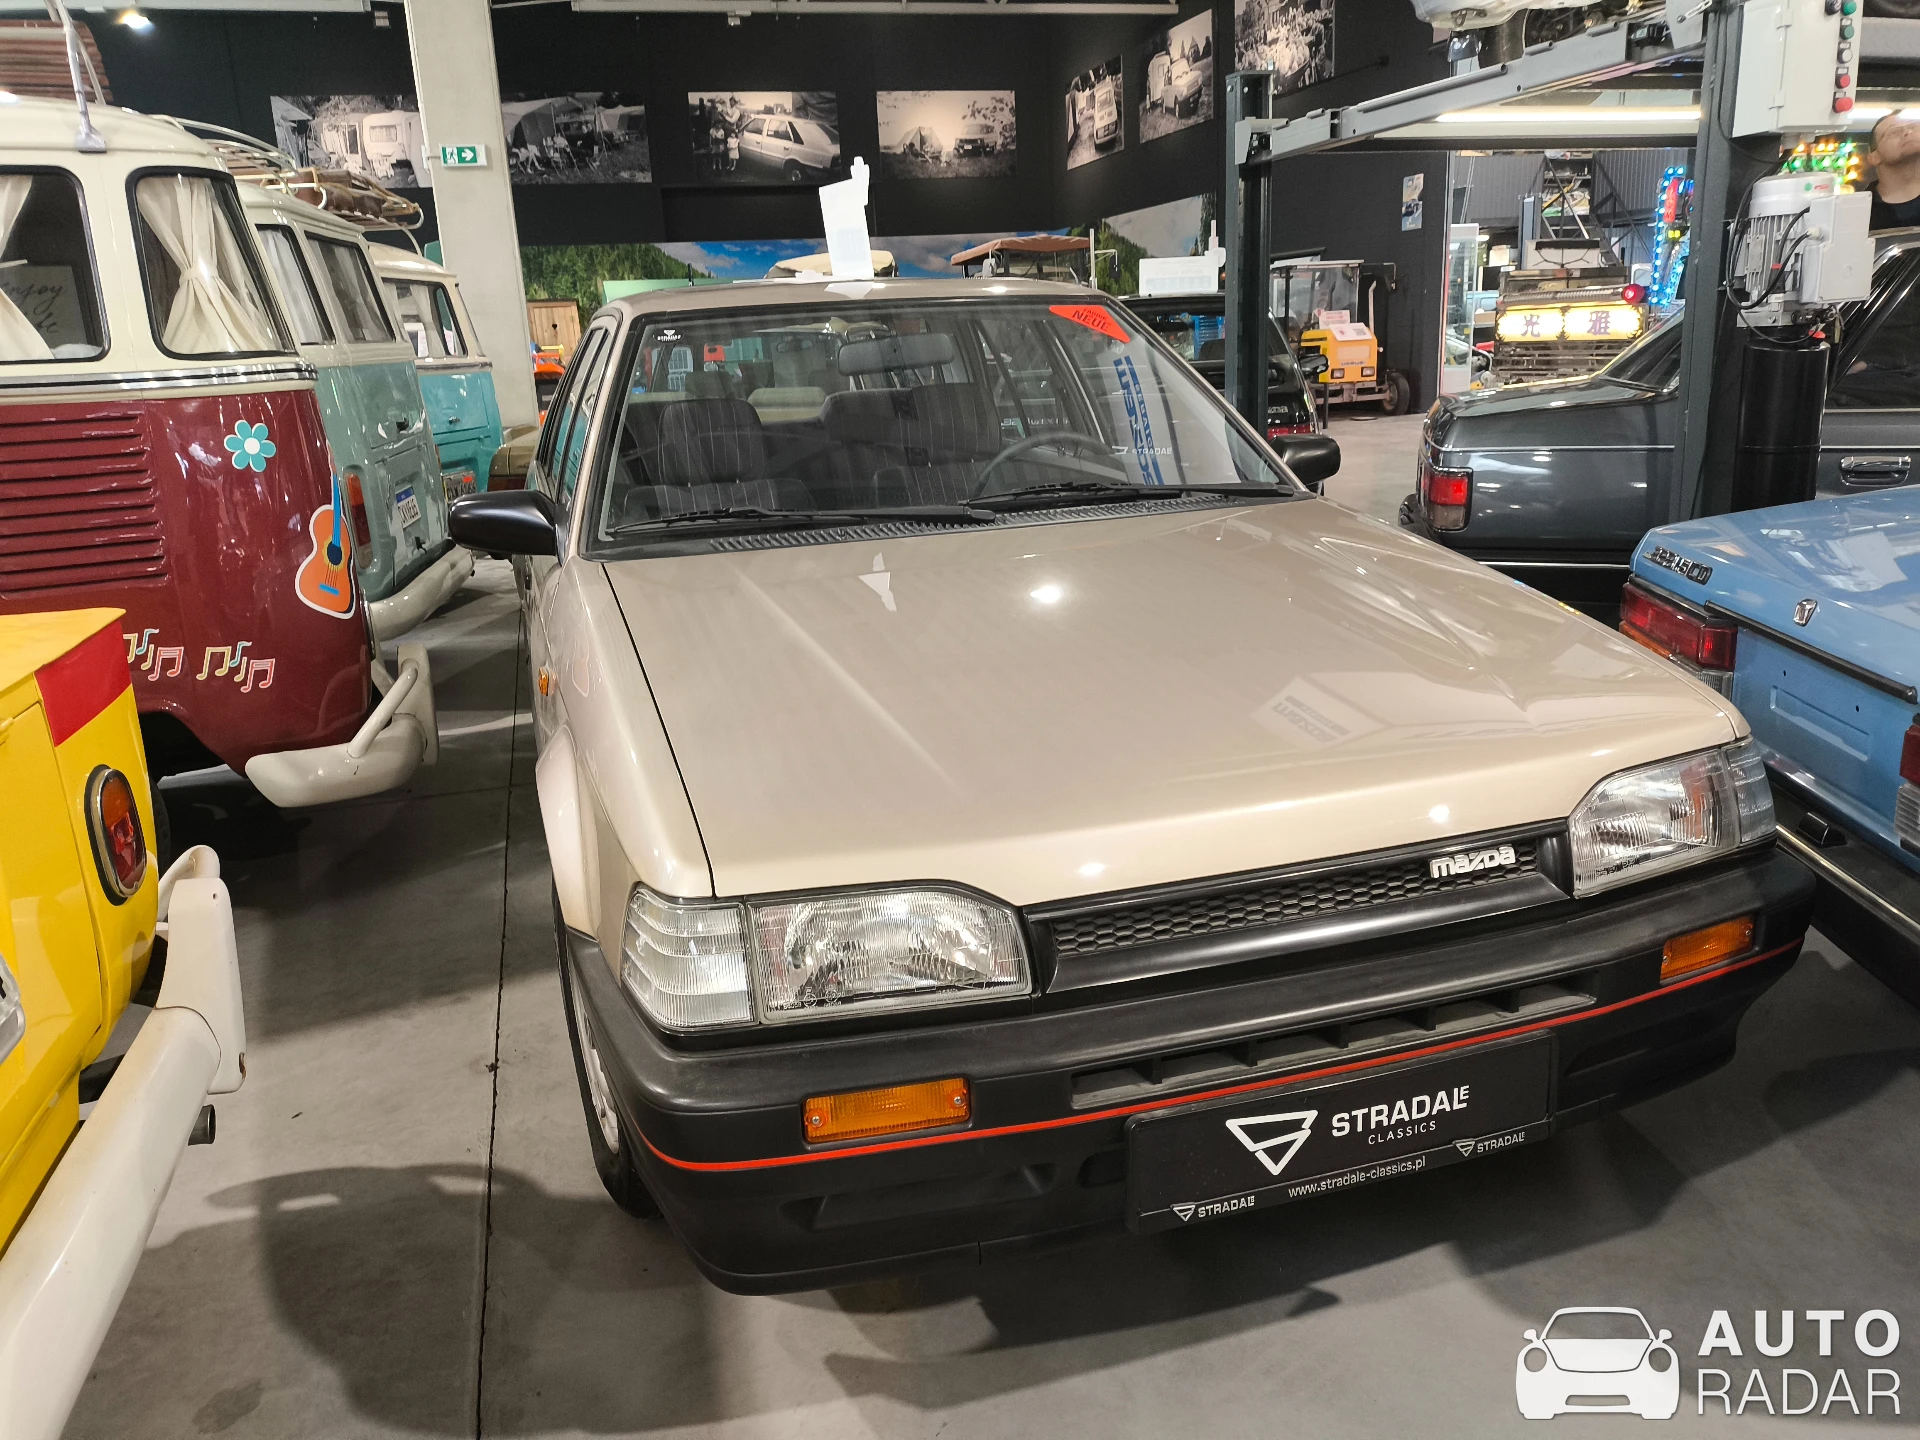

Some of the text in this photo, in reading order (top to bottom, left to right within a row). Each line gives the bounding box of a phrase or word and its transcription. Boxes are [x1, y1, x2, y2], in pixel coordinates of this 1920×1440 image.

[1072, 310, 1111, 332] NEUE
[1331, 1085, 1470, 1137] STRADALE
[1368, 1120, 1437, 1145] CLASSICS
[1476, 1131, 1526, 1154] STRADALE
[1287, 1155, 1426, 1199] www.stradale-classics.pl
[1197, 1195, 1255, 1219] STRADALE
